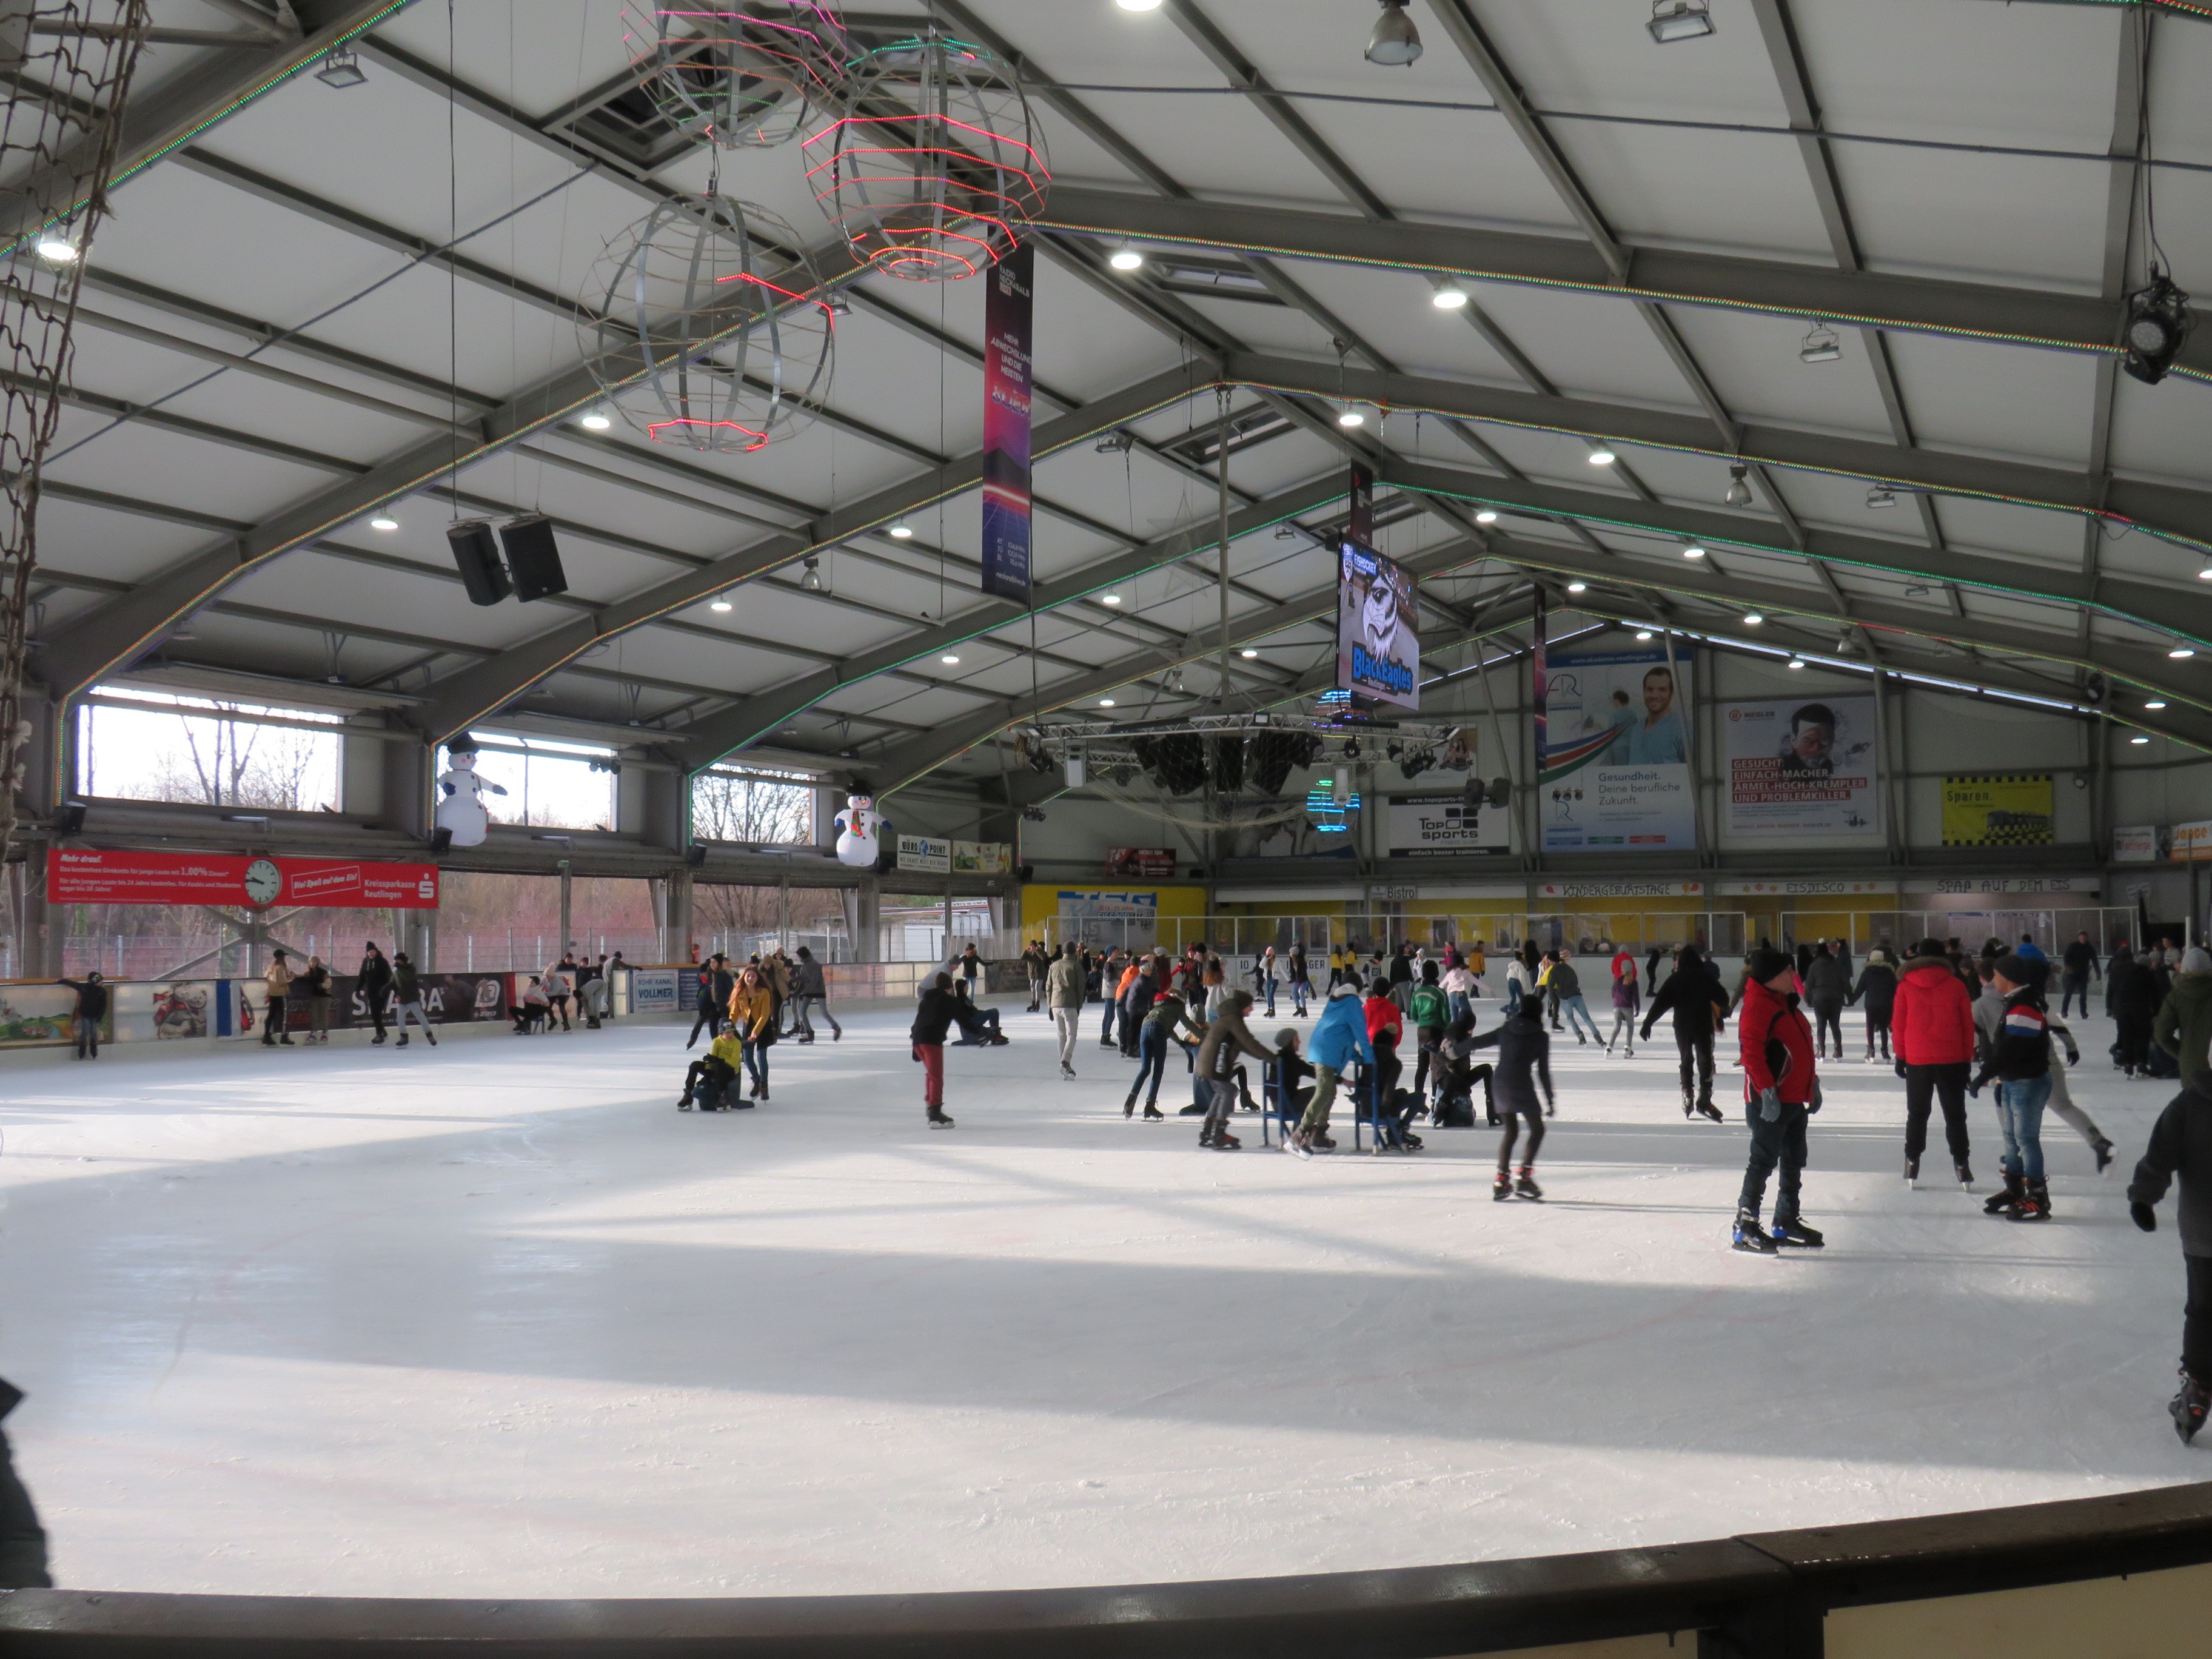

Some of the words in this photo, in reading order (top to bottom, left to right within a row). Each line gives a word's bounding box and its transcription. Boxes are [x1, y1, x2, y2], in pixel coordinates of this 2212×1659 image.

[999, 265, 1016, 280] RADIO
[1004, 332, 1019, 347] MEHR
[991, 337, 1031, 365] ABWECHSLUNG
[1002, 354, 1013, 367] UND
[1013, 360, 1022, 372] DIE
[1000, 365, 1023, 383] MEISTEN
[1354, 554, 1376, 575] EISHOCKEY
[1598, 772, 1660, 782] Gesundheit.
[1598, 784, 1628, 794] Deine
[1631, 782, 1681, 793] berufliche
[1734, 779, 1866, 792] ÄRMEL-HOCH-KREMPLER
[1599, 796, 1638, 806] Zukunft.
[1761, 791, 1850, 801] PROBLEMKILLER.
[1947, 791, 1993, 803] Sparen.
[1418, 817, 1445, 830] Top
[1421, 830, 1478, 841] sports
[902, 839, 918, 851] BÜRO
[930, 844, 945, 854] POINT
[61, 854, 79, 862] Mehr
[181, 867, 207, 876] 1,00%
[306, 878, 321, 889] Spaß
[323, 876, 333, 885] auf
[364, 879, 415, 889] Kreissparkasse
[1787, 882, 1845, 893] EISDISCO
[1982, 879, 2009, 892] AUF
[2019, 879, 2043, 891] DEM
[2049, 879, 2070, 891] EIS
[364, 890, 402, 900] Reutlingen
[1388, 886, 1415, 899] Bistro
[1563, 884, 1671, 897] KINDERGEBURTSTAGE
[638, 988, 673, 999] VOLLMER
